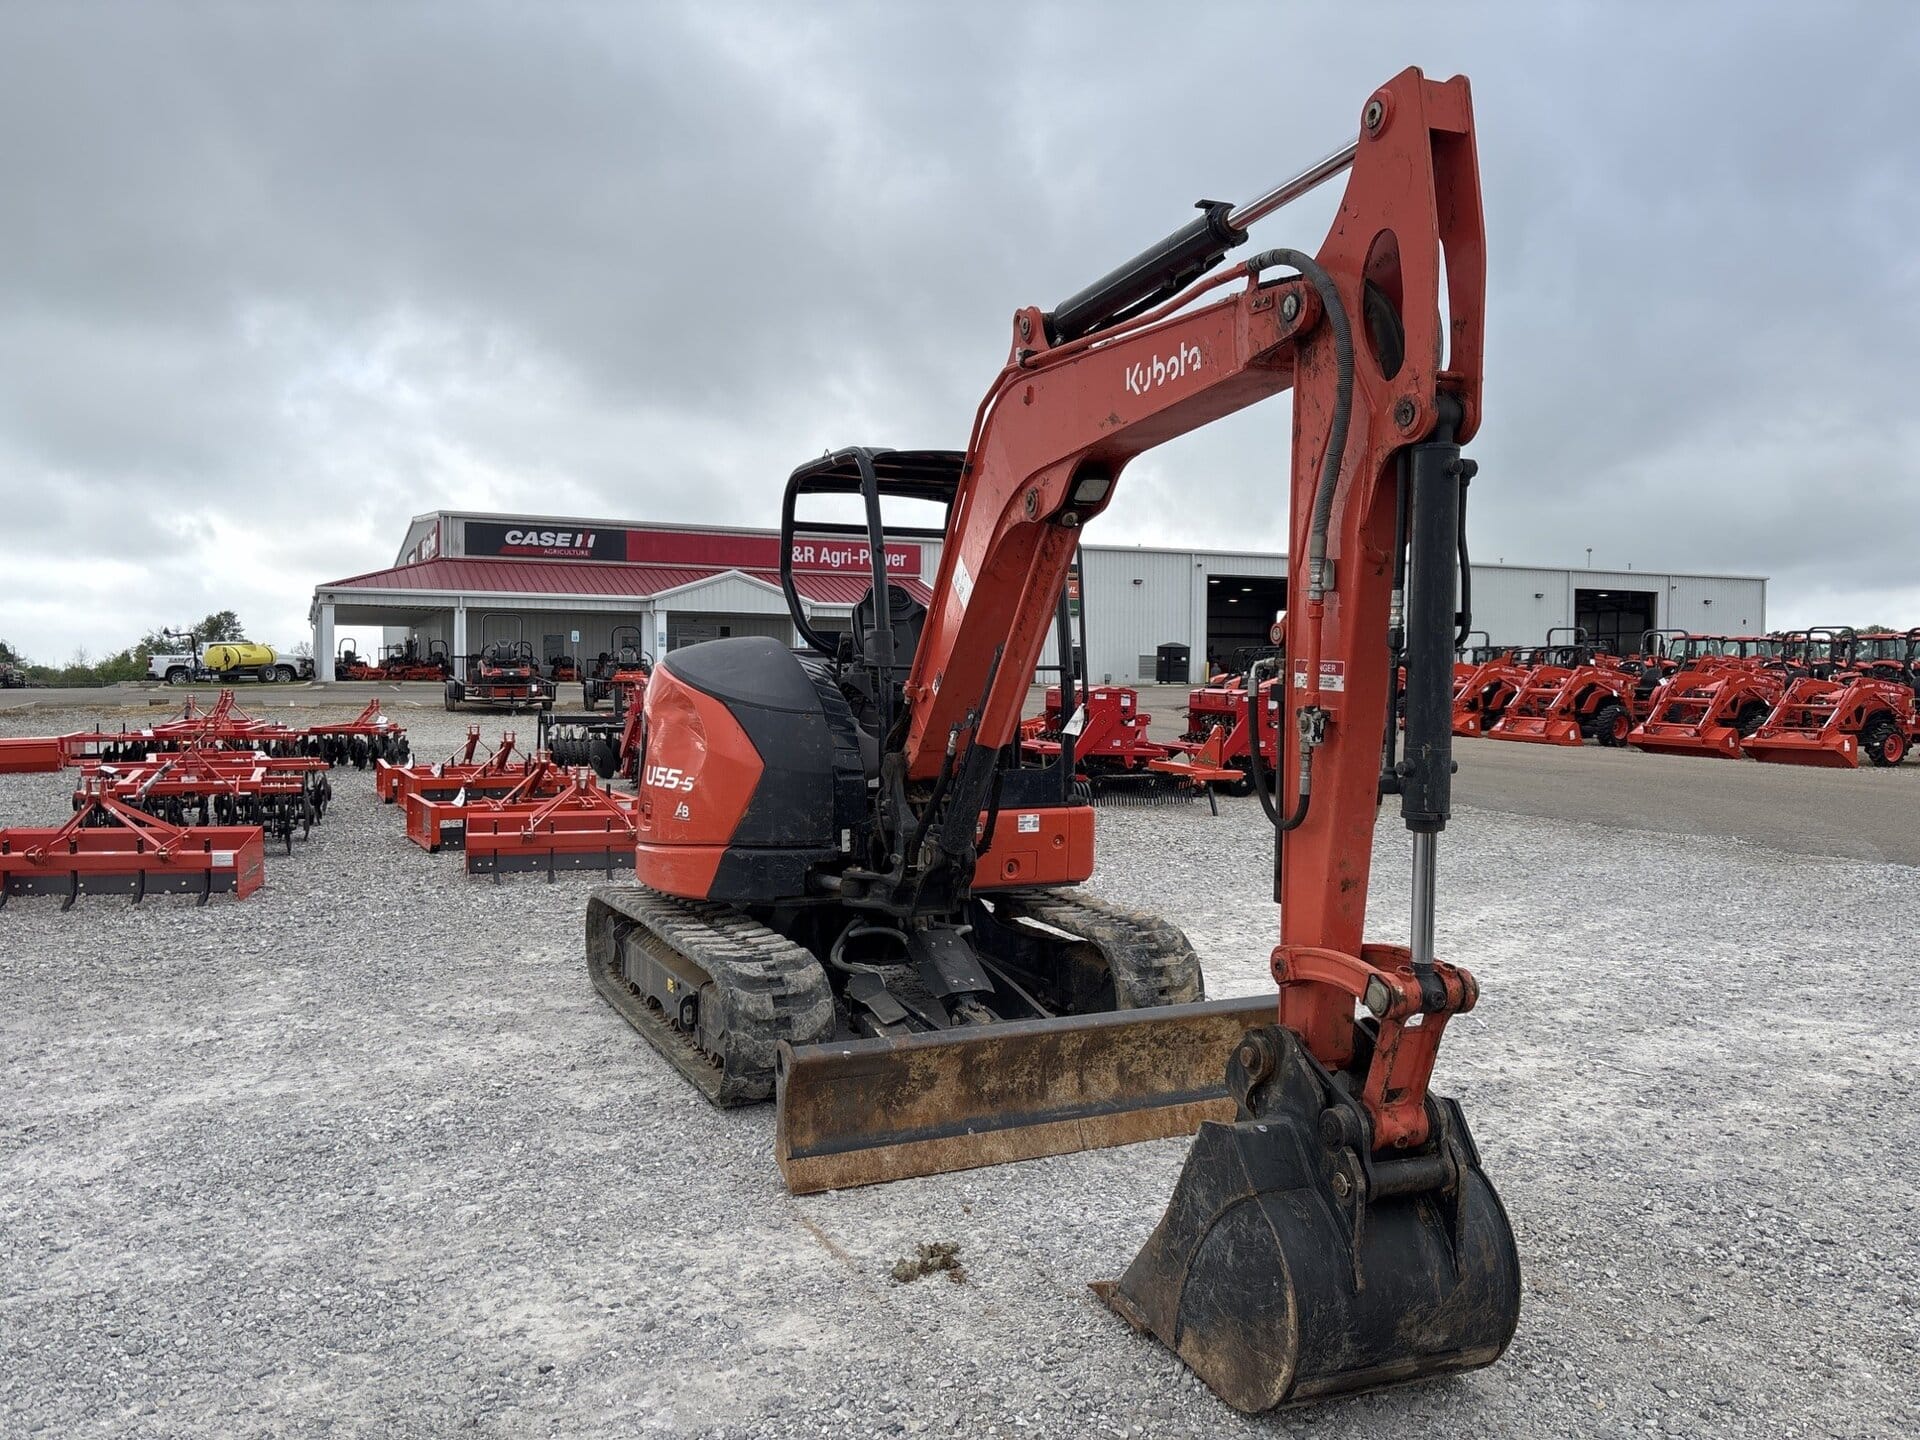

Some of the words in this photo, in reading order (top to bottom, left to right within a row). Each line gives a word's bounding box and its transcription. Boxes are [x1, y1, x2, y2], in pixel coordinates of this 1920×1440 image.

[1126, 342, 1202, 395] Kubota
[505, 530, 572, 547] CASE
[543, 548, 589, 557] AGRICULTURE
[791, 545, 815, 563] &R
[819, 547, 908, 568] Agri-Per
